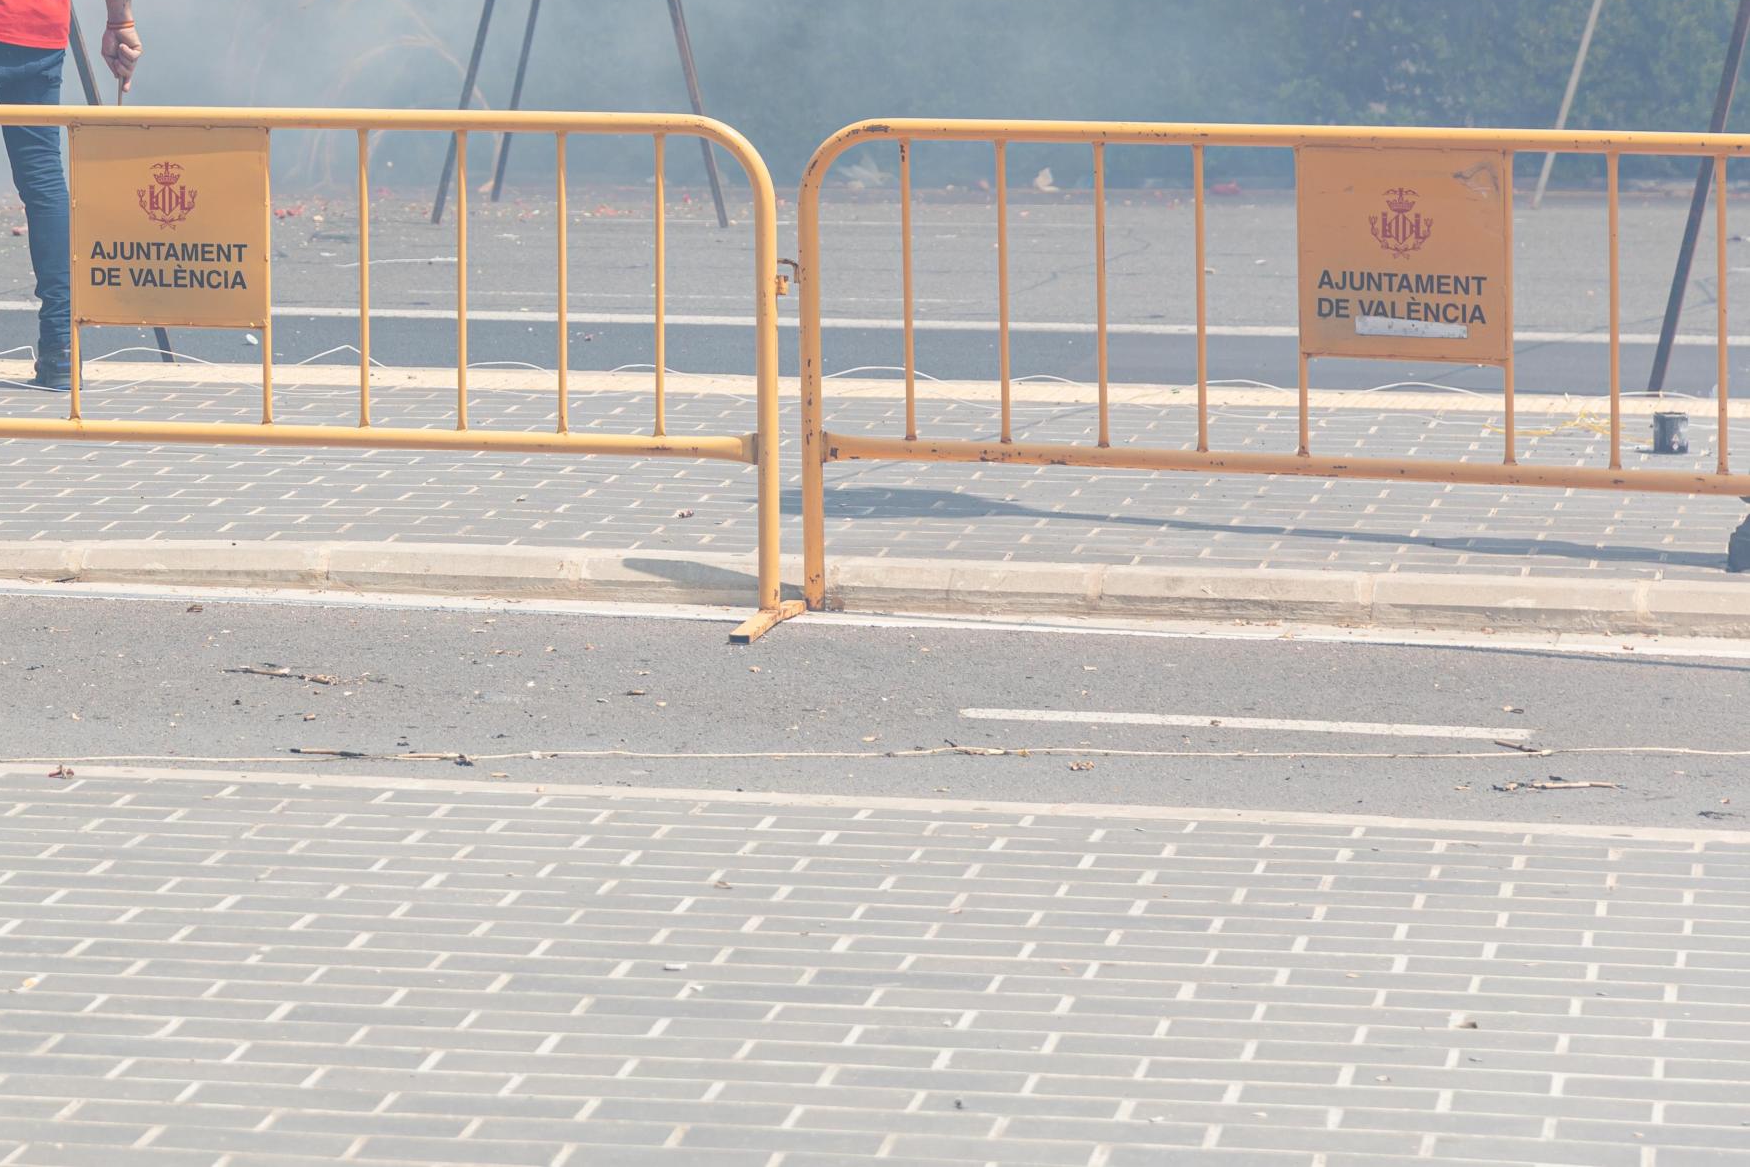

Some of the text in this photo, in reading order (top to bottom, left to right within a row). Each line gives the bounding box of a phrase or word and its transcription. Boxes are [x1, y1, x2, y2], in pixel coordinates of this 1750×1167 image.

[90, 241, 248, 262] AJUNTAMENT
[90, 264, 247, 289] DE VALÈNCIA
[1317, 270, 1488, 295] AJUNTAMENT
[1317, 297, 1486, 324] DE VALÈNCIA
